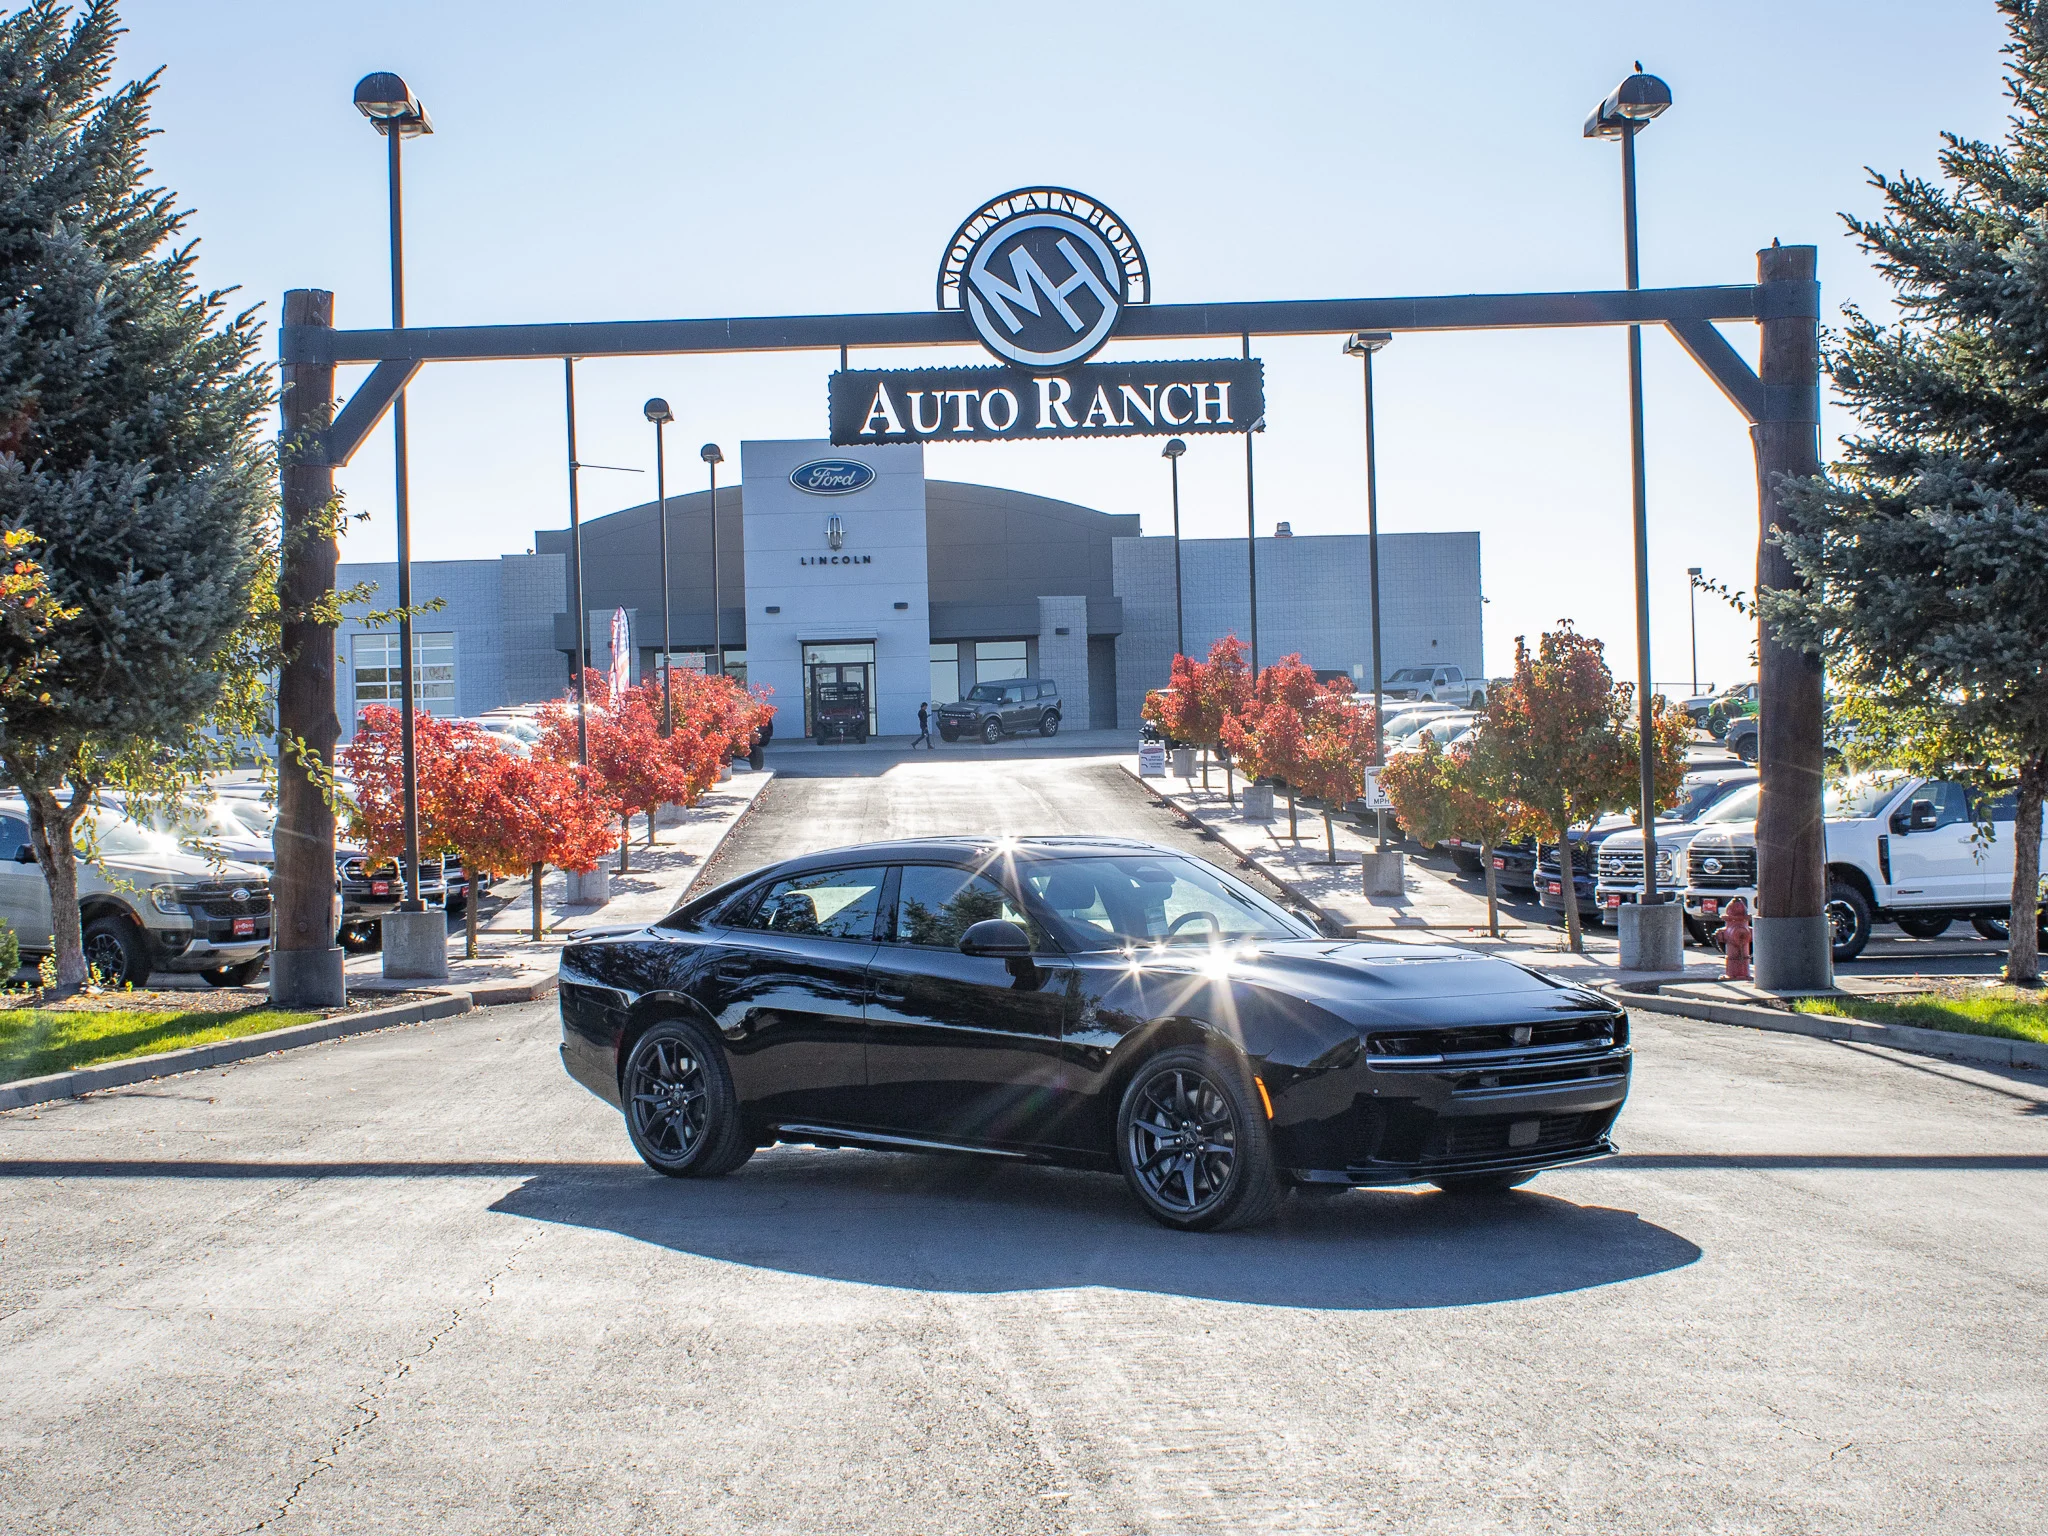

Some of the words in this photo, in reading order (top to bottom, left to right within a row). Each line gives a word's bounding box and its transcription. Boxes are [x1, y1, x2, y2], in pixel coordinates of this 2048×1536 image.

[943, 191, 1077, 289] MOUNTAIN
[1088, 207, 1144, 286] HOME
[859, 382, 1019, 435] AUTO
[1032, 377, 1234, 430] RANCH
[808, 466, 856, 487] Ford
[800, 555, 871, 566] LINCOLN
